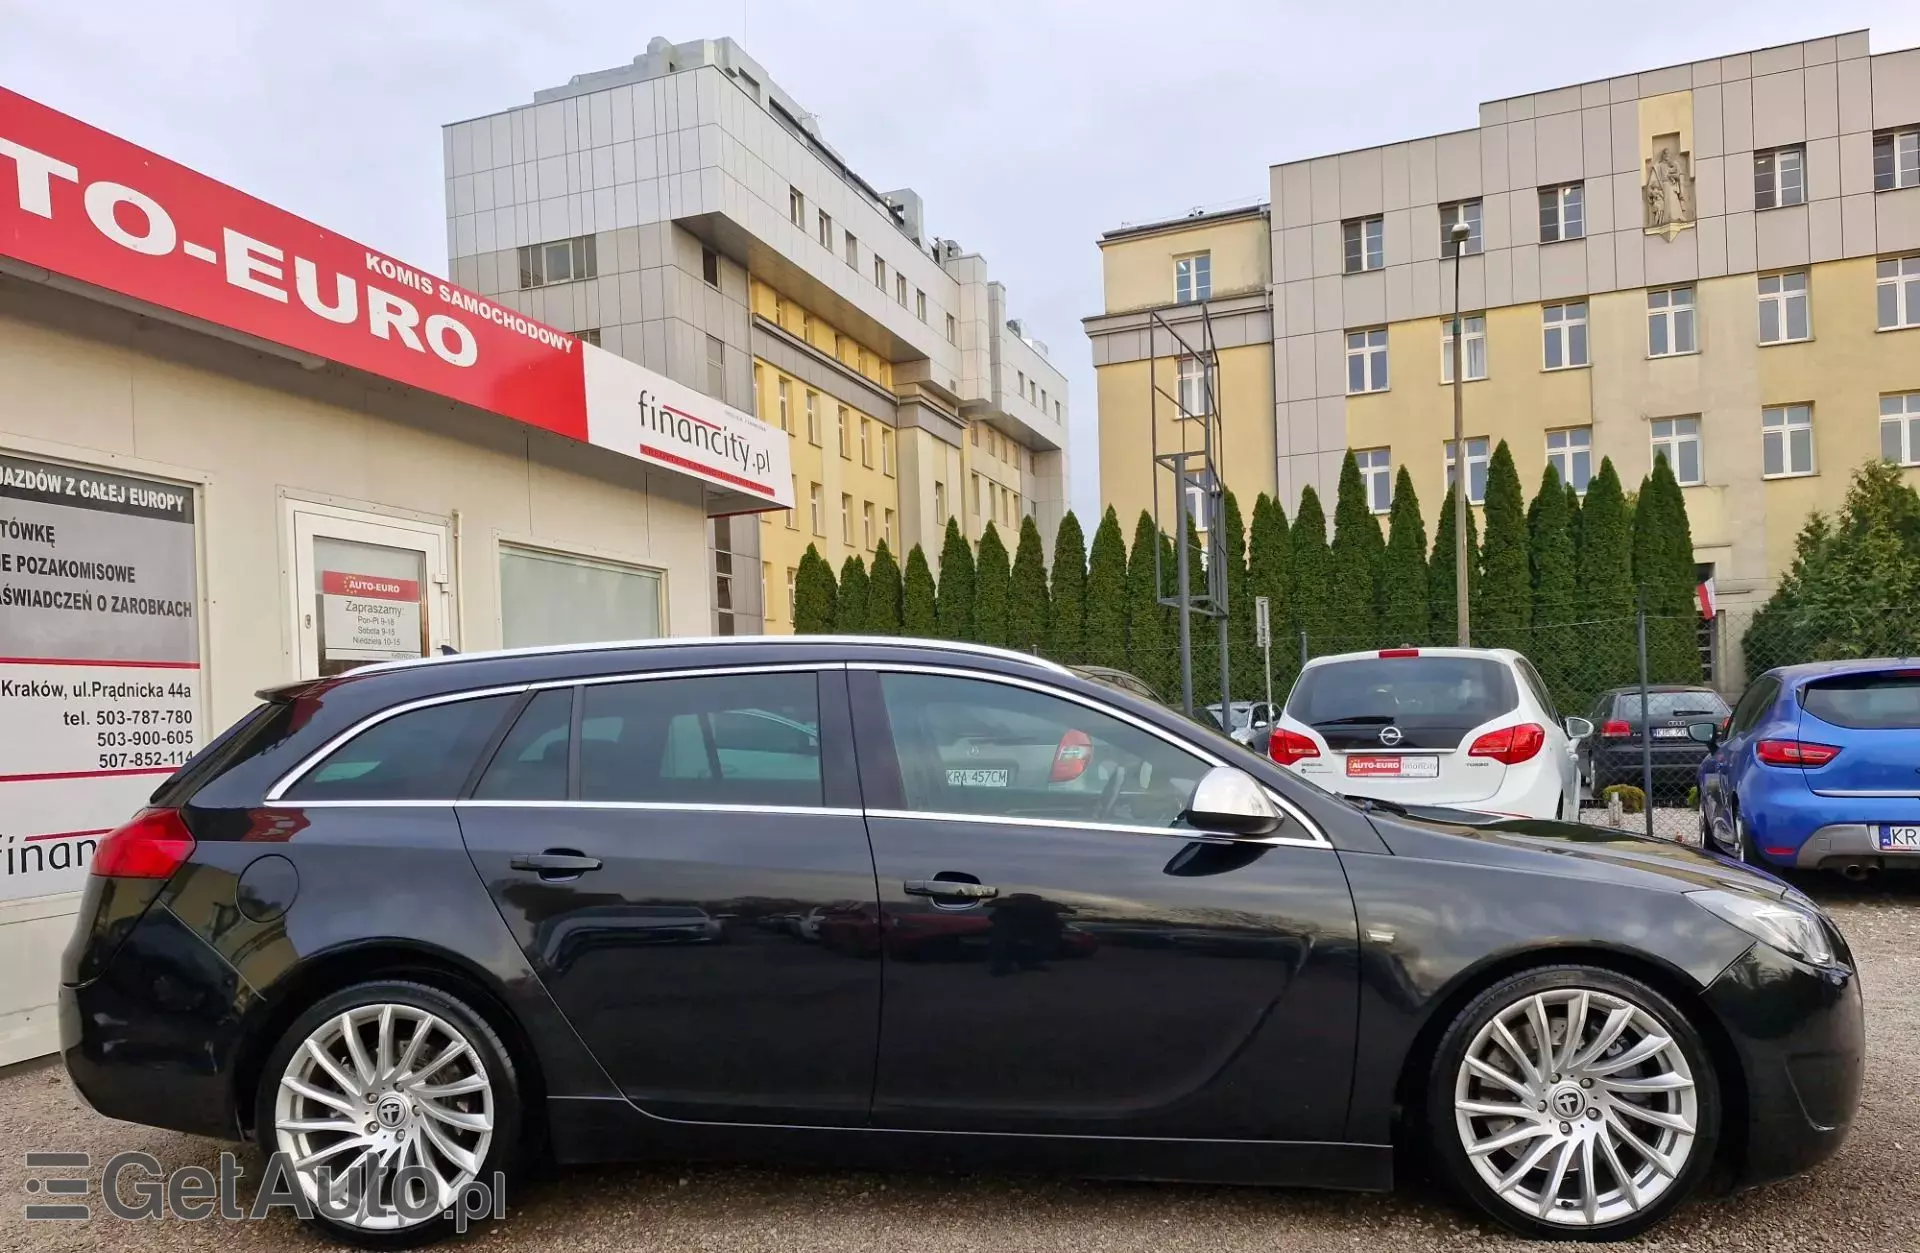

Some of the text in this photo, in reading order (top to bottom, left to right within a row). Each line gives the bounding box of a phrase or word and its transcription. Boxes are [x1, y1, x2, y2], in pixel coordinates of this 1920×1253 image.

[0, 136, 478, 368] TO-EURO
[365, 252, 573, 354] KOMIS SAMOCHODOWY
[638, 390, 771, 475] financity.pl
[65, 477, 76, 496] Z
[79, 479, 126, 503] CAŁEJ
[129, 487, 184, 513] EUROPY
[17, 555, 136, 583] POZAKOMISOWE
[349, 580, 400, 593] AUTO-EURO
[97, 594, 107, 612] O
[111, 595, 192, 618] ZAROBKACH
[1, 679, 191, 701] Kraków, ul.Prądnicka 44a
[63, 710, 193, 726] tel. 503-787-780
[97, 730, 194, 746] 503-900-605
[99, 750, 194, 768] 507-852-114
[1352, 762, 1400, 770] AUTO-EURO
[971, 770, 1007, 783] 457CM
[0, 834, 97, 875] inan
